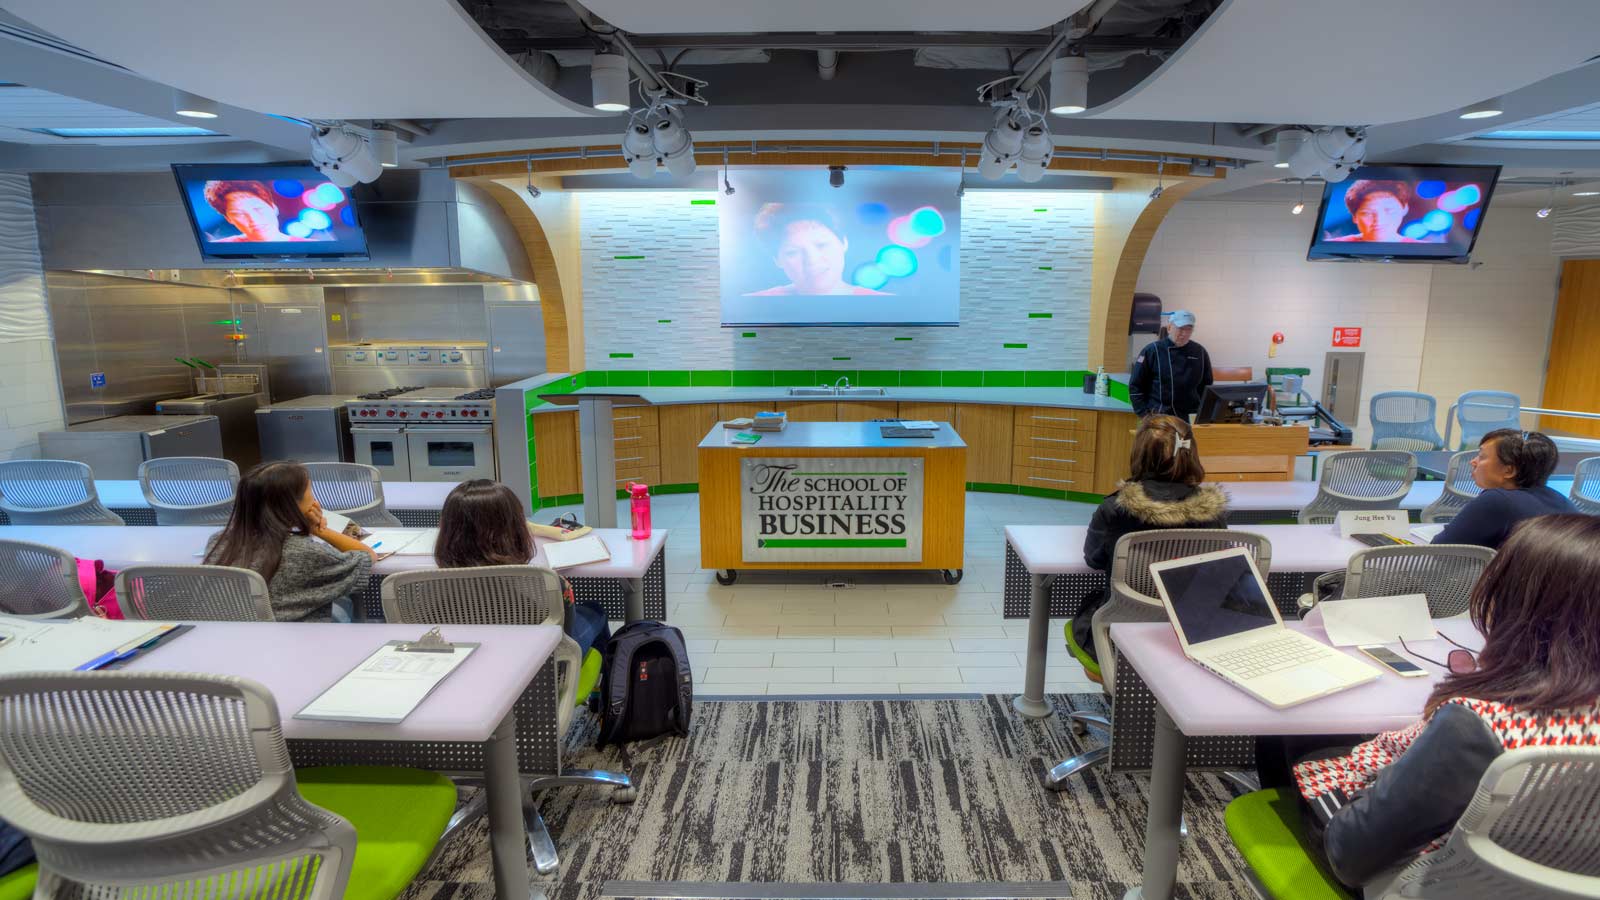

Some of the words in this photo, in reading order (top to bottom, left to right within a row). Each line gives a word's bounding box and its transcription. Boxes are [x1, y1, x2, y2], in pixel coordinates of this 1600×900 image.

[750, 464, 801, 494] The
[804, 478, 880, 492] SCHOOL
[883, 478, 907, 492] OF
[758, 495, 908, 511] HOSPITALITY
[758, 514, 906, 535] BUSINESS
[1353, 514, 1371, 522] Jung
